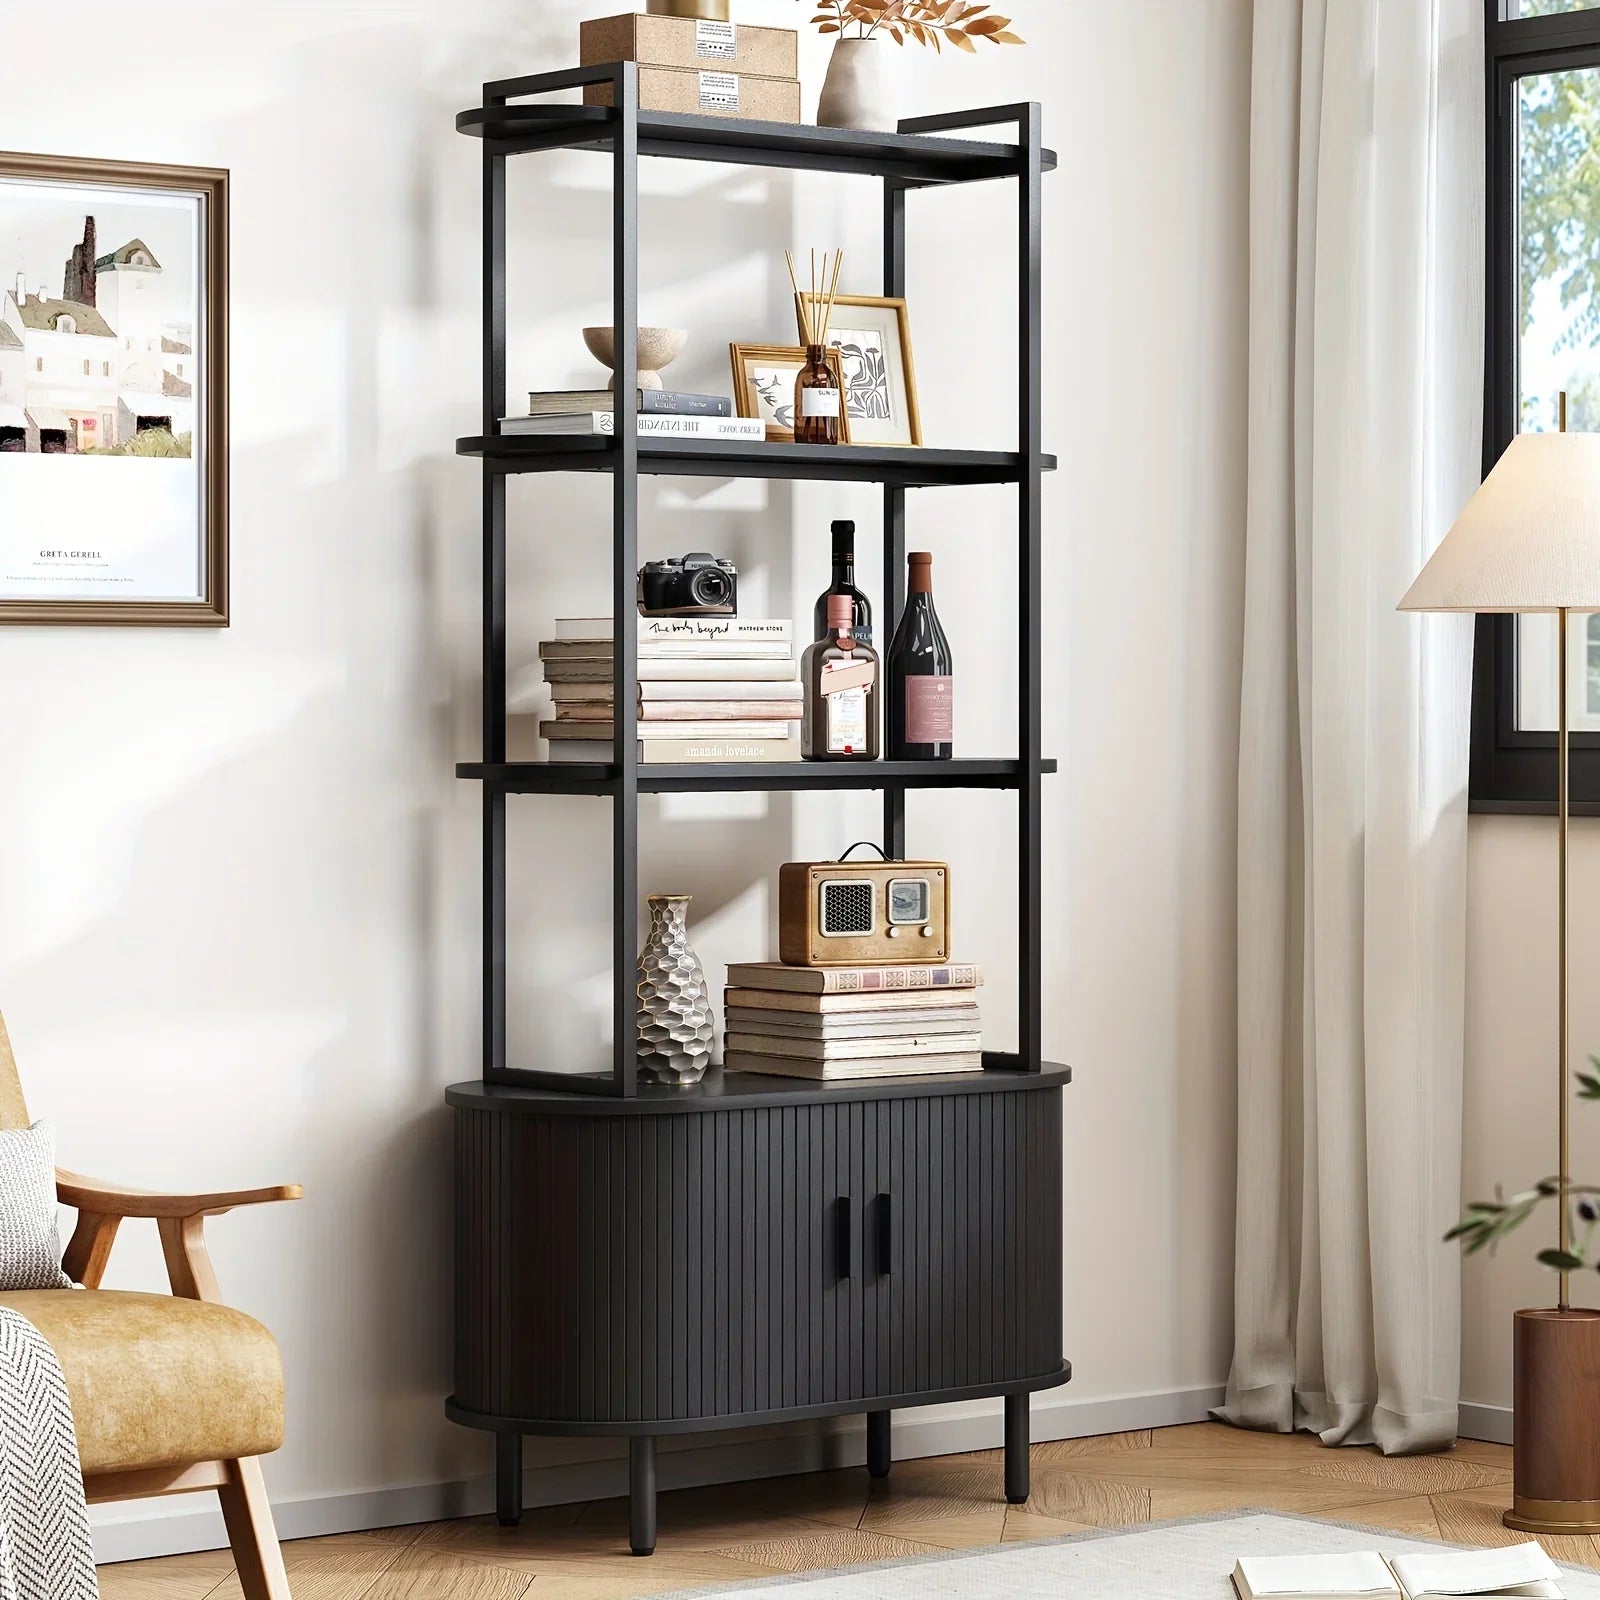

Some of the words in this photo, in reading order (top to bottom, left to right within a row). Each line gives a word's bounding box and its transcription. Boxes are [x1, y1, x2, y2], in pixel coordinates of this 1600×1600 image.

[70, 551, 102, 559] GERELL
[649, 622, 670, 633] The
[672, 620, 693, 634] body
[684, 745, 722, 756] amanda
[725, 745, 765, 756] lovelace
